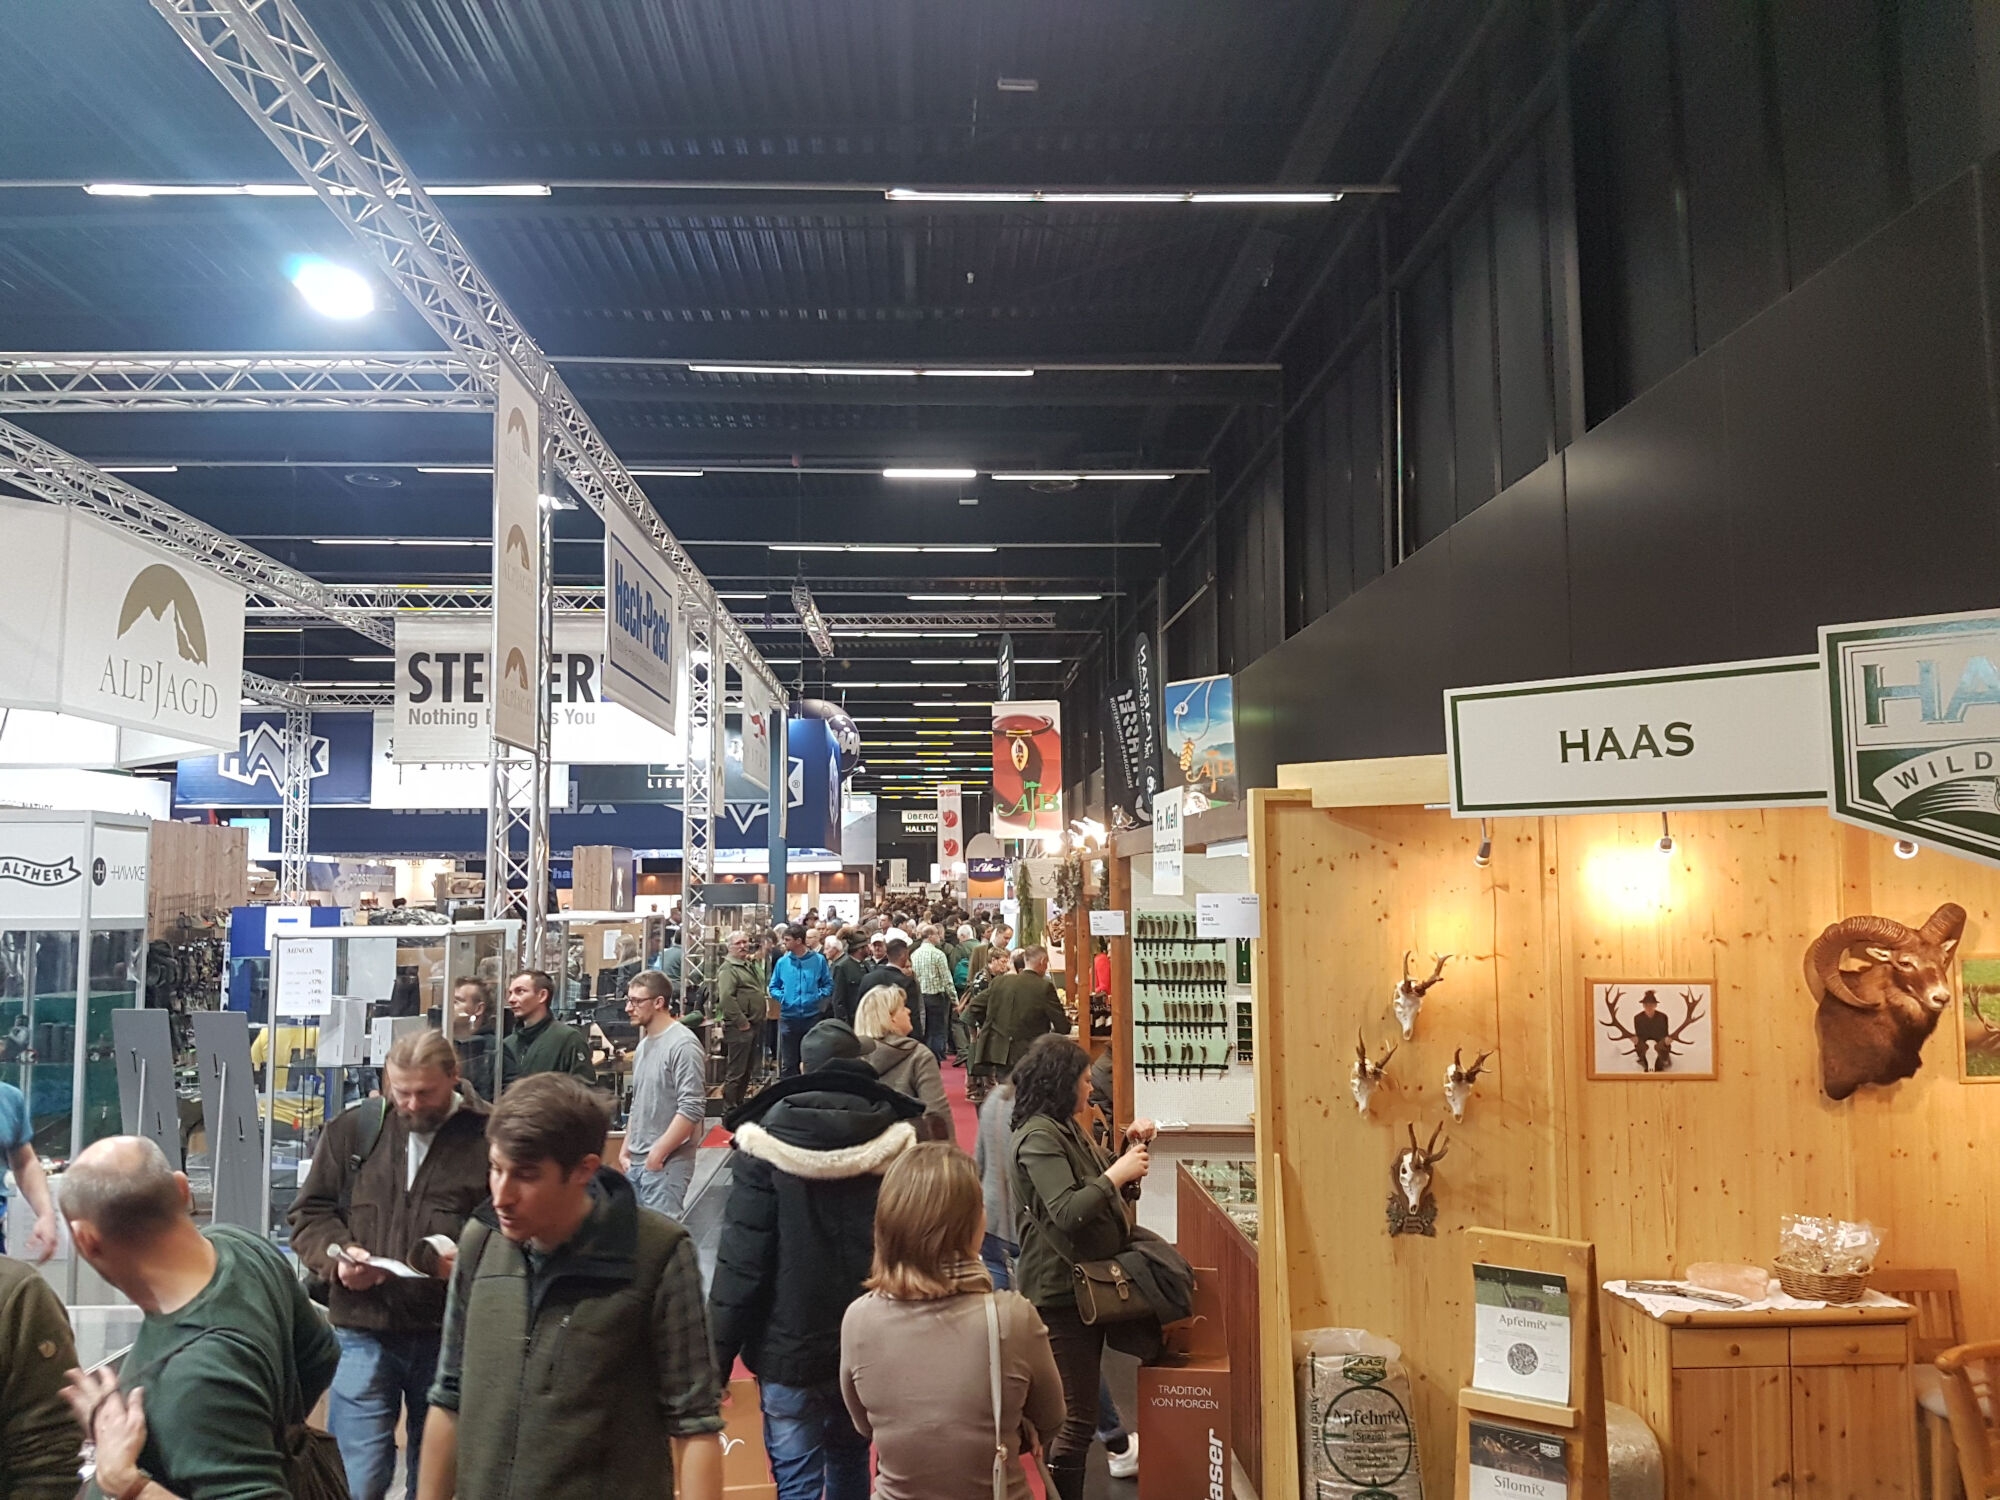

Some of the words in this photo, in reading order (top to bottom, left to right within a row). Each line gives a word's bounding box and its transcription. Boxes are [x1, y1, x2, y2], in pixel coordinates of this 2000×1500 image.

[615, 558, 670, 666] Heck-Pack
[98, 654, 218, 720] ALPJAGD
[408, 708, 478, 729] Nothing
[564, 708, 596, 726] You
[1559, 722, 1695, 763] HAAS
[905, 825, 937, 833] HALLEN
[1158, 1384, 1212, 1397] TRADITION
[1151, 1397, 1173, 1408] VON
[1175, 1398, 1219, 1410] MORGEN
